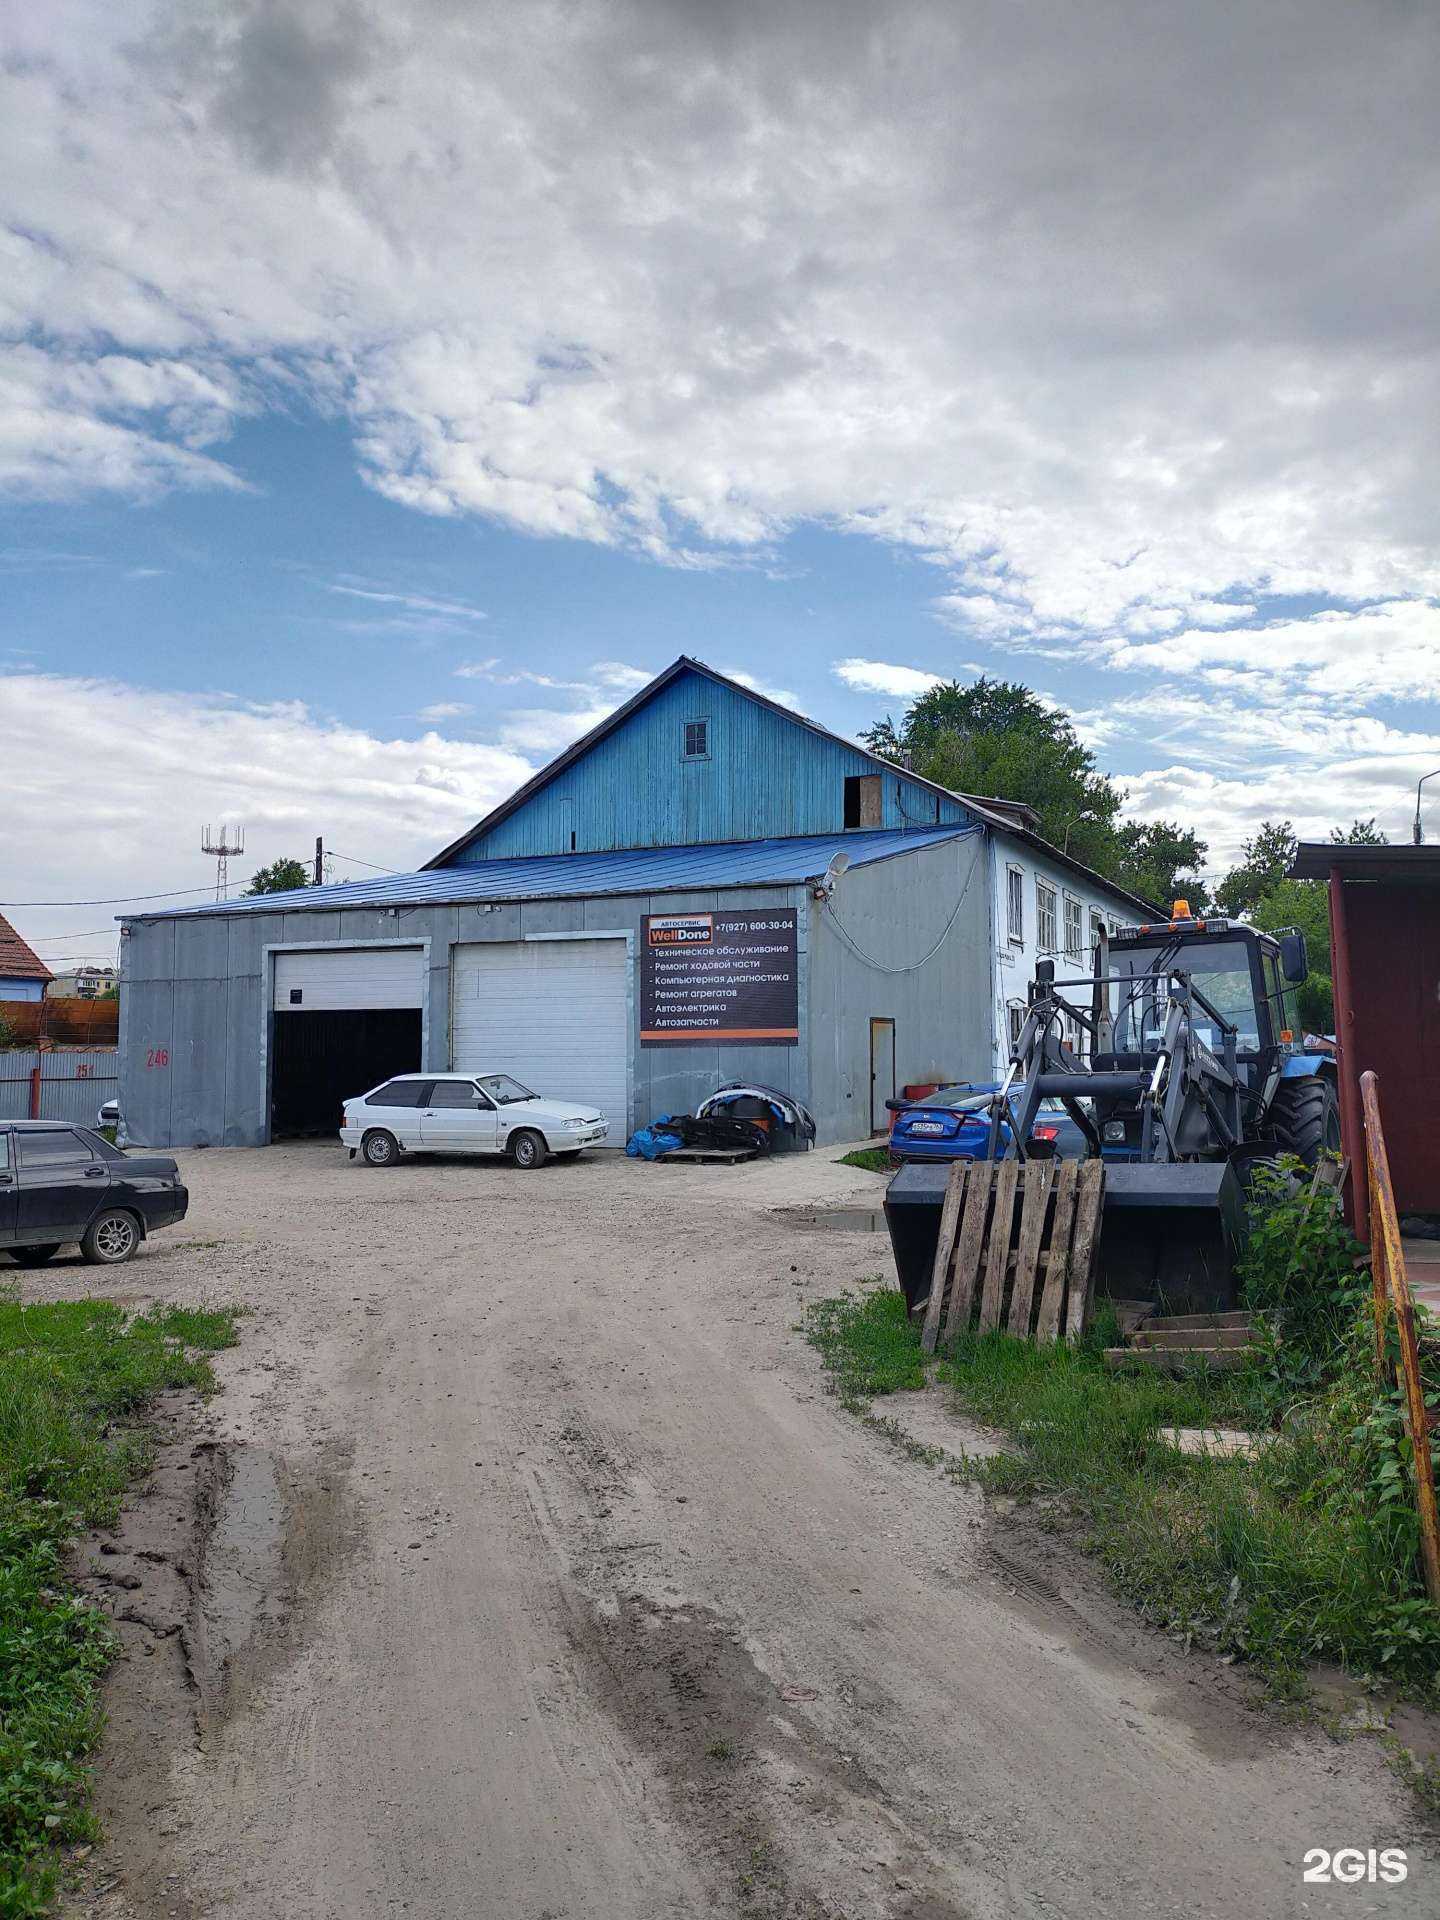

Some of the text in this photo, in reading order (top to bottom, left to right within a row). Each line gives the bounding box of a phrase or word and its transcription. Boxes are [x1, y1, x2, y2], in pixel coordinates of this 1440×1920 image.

[660, 919, 701, 928] АВТОСЕРВИС
[715, 920, 794, 933] +7(927) 600-30-04
[651, 930, 710, 941] WellDone
[655, 944, 789, 958] Техническое обслуживание
[655, 960, 760, 971] Ремонт ходовой части
[655, 973, 789, 986] Компьютерная диагностика
[655, 988, 738, 1000] Ремонт агрегатов
[655, 1003, 727, 1014] Автоэлектрика
[655, 1018, 719, 1028] Автозапчасти
[146, 1048, 169, 1068] 246
